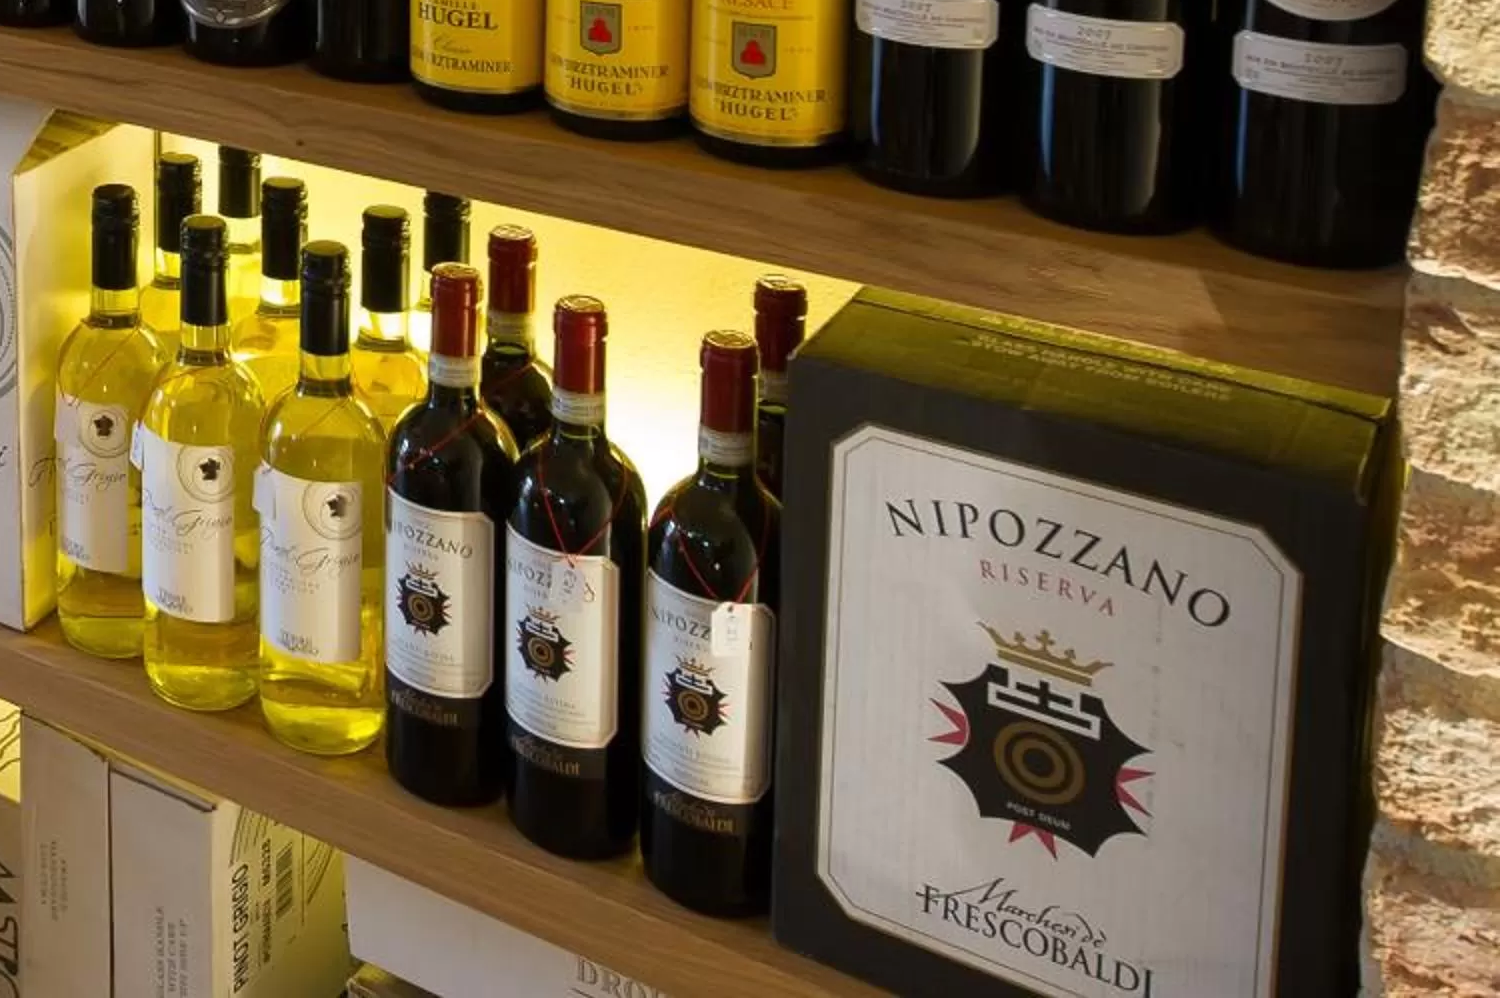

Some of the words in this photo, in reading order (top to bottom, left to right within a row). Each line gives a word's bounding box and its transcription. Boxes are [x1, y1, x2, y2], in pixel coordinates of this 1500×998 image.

[417, 0, 500, 31] HUGEL
[885, 498, 1232, 629] NIPOZZANO
[980, 558, 1116, 618] RISERVA
[1007, 801, 1035, 817] POST
[232, 864, 249, 933] GRIGIO
[232, 936, 249, 994] PINOT
[924, 883, 1155, 998] FRESCOBALDI
